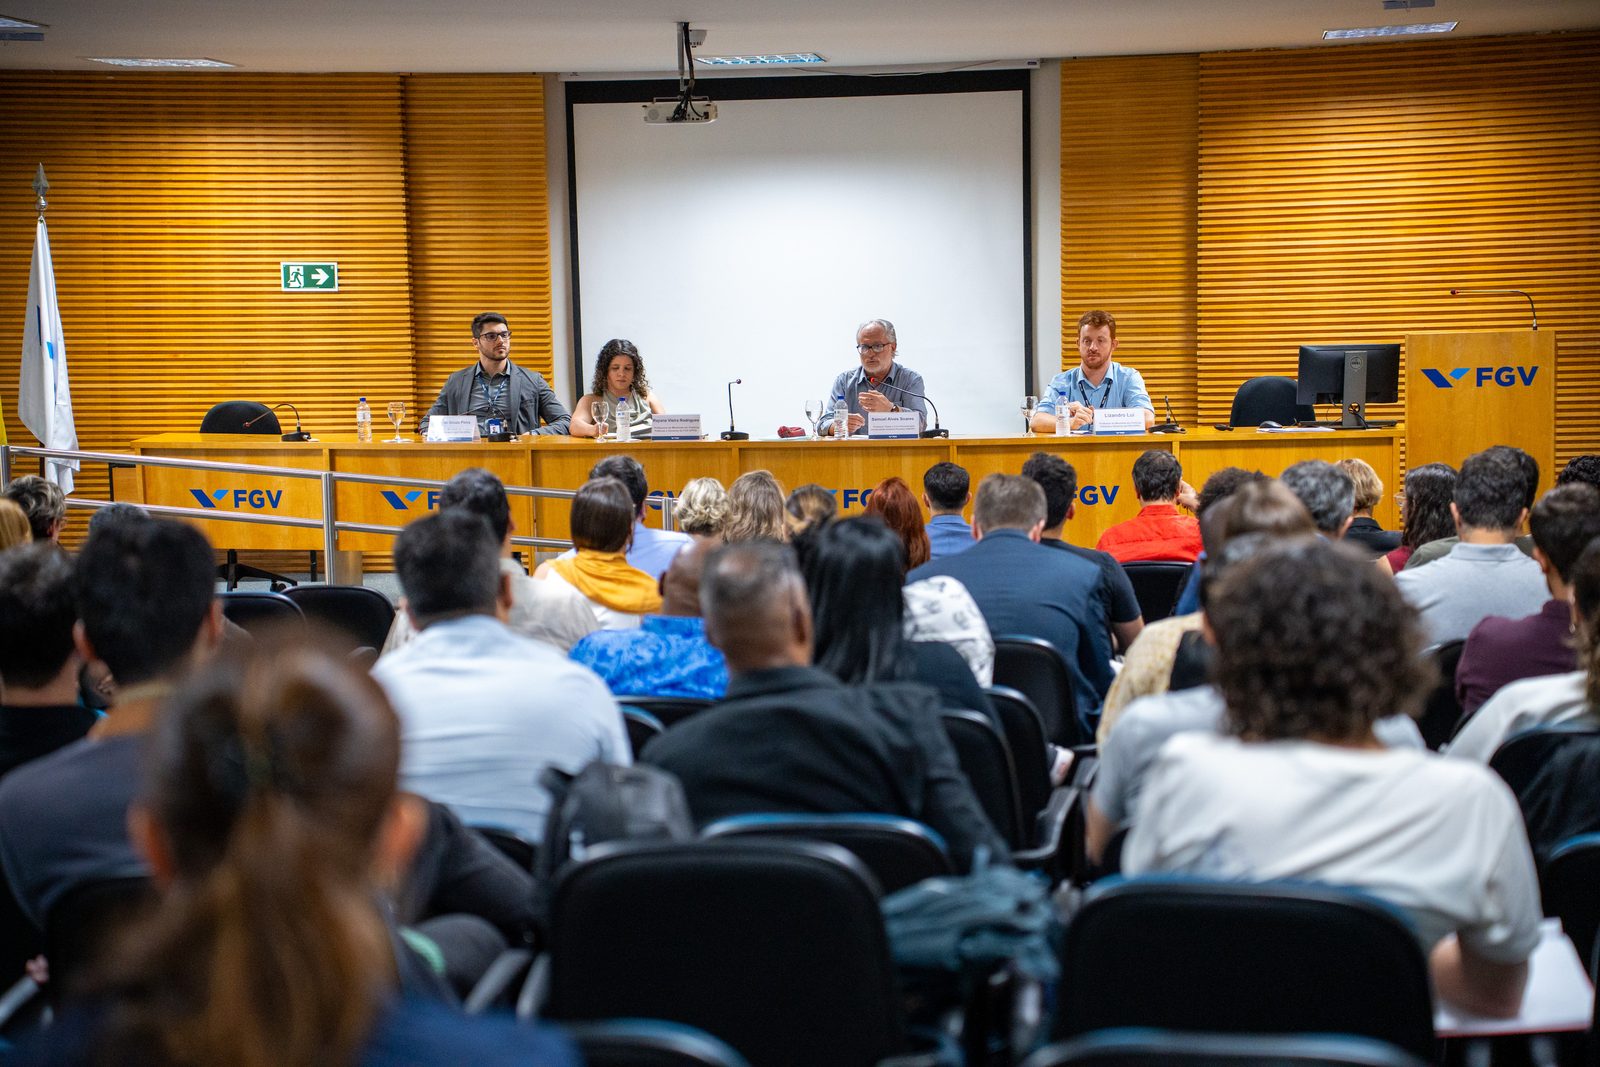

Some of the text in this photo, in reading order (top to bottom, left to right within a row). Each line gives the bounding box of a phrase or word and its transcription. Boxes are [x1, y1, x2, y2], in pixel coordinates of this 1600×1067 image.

[1476, 366, 1539, 387] FGV
[233, 489, 283, 508] FGV
[1073, 485, 1120, 505] GV
